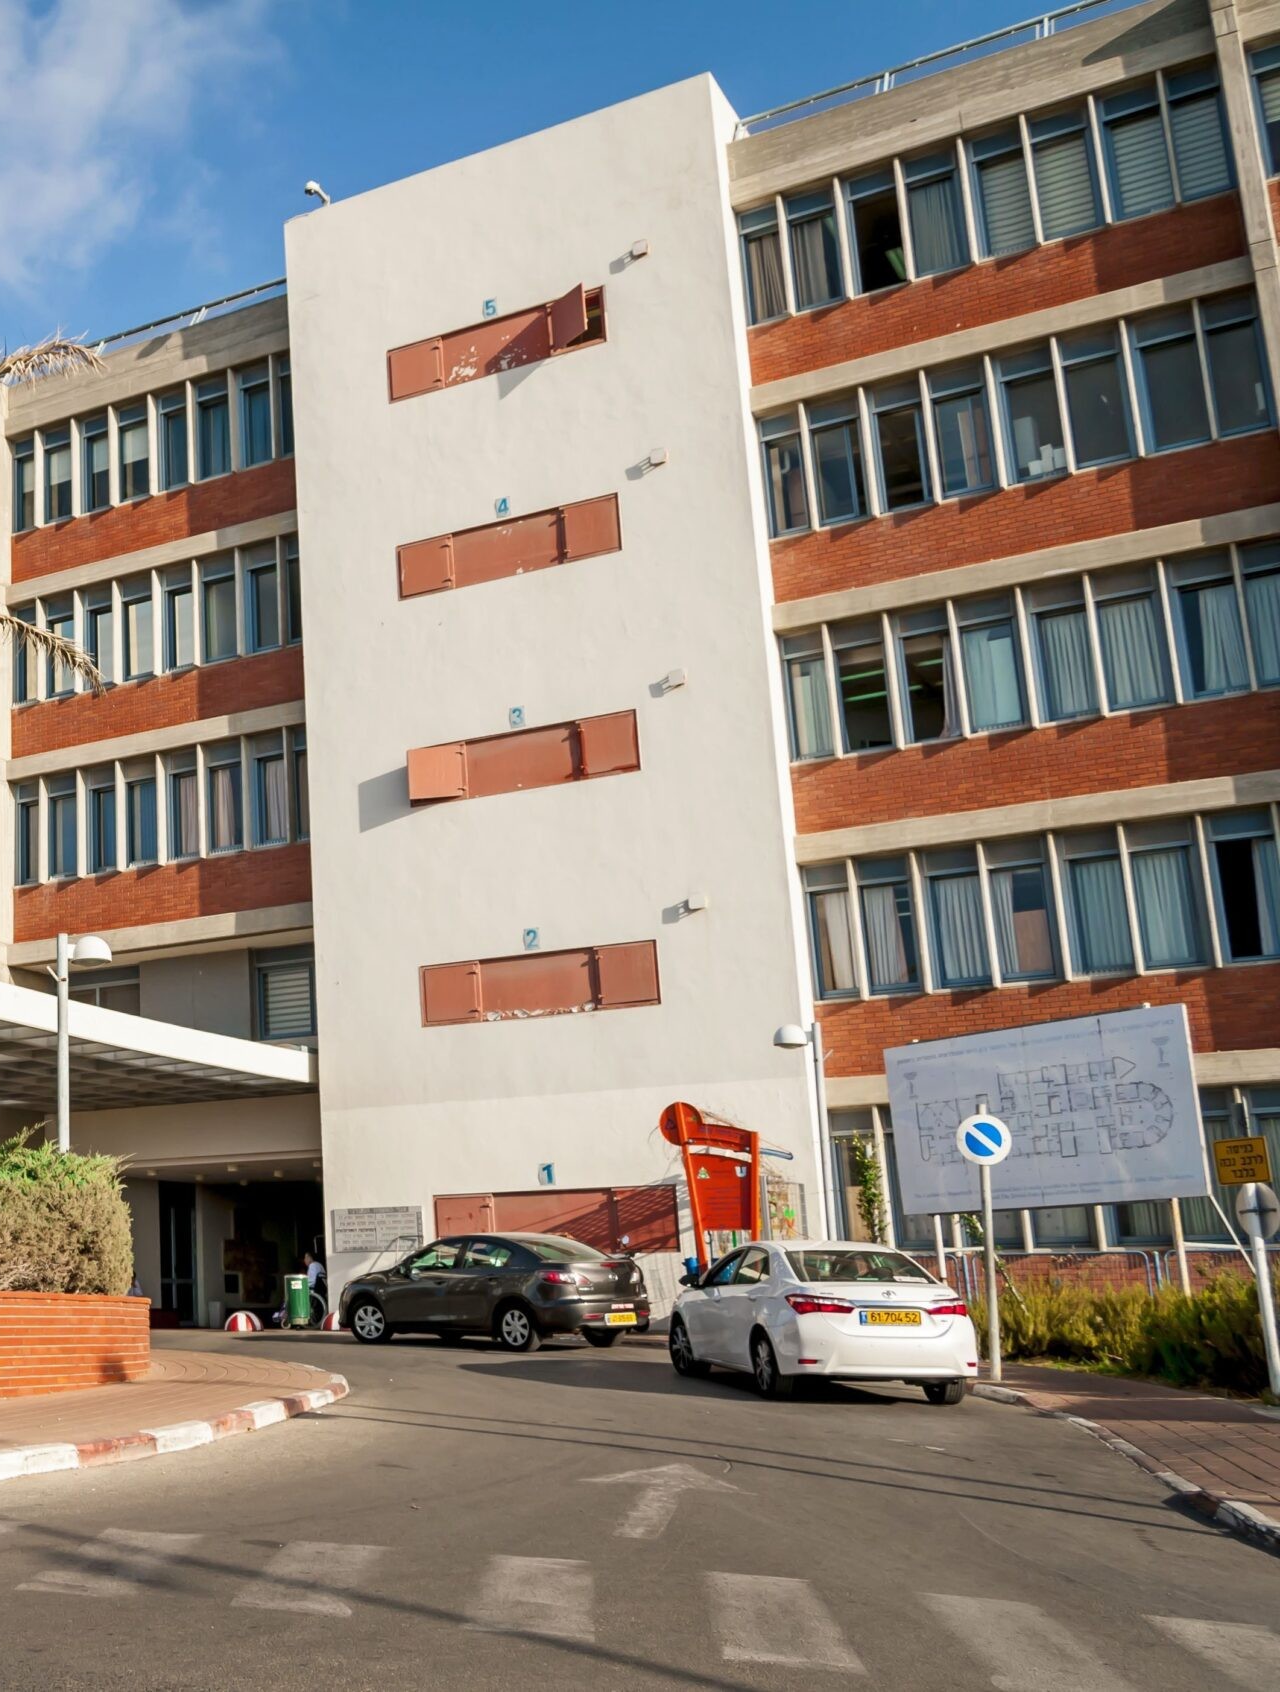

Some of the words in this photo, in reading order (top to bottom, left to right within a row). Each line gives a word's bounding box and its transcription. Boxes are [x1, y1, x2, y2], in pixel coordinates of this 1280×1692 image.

[485, 299, 496, 316] 5
[498, 498, 508, 513] 4
[512, 708, 523, 725] 3
[526, 929, 539, 949] 2
[542, 1164, 553, 1184] 1
[1231, 1168, 1255, 1178] בלבד
